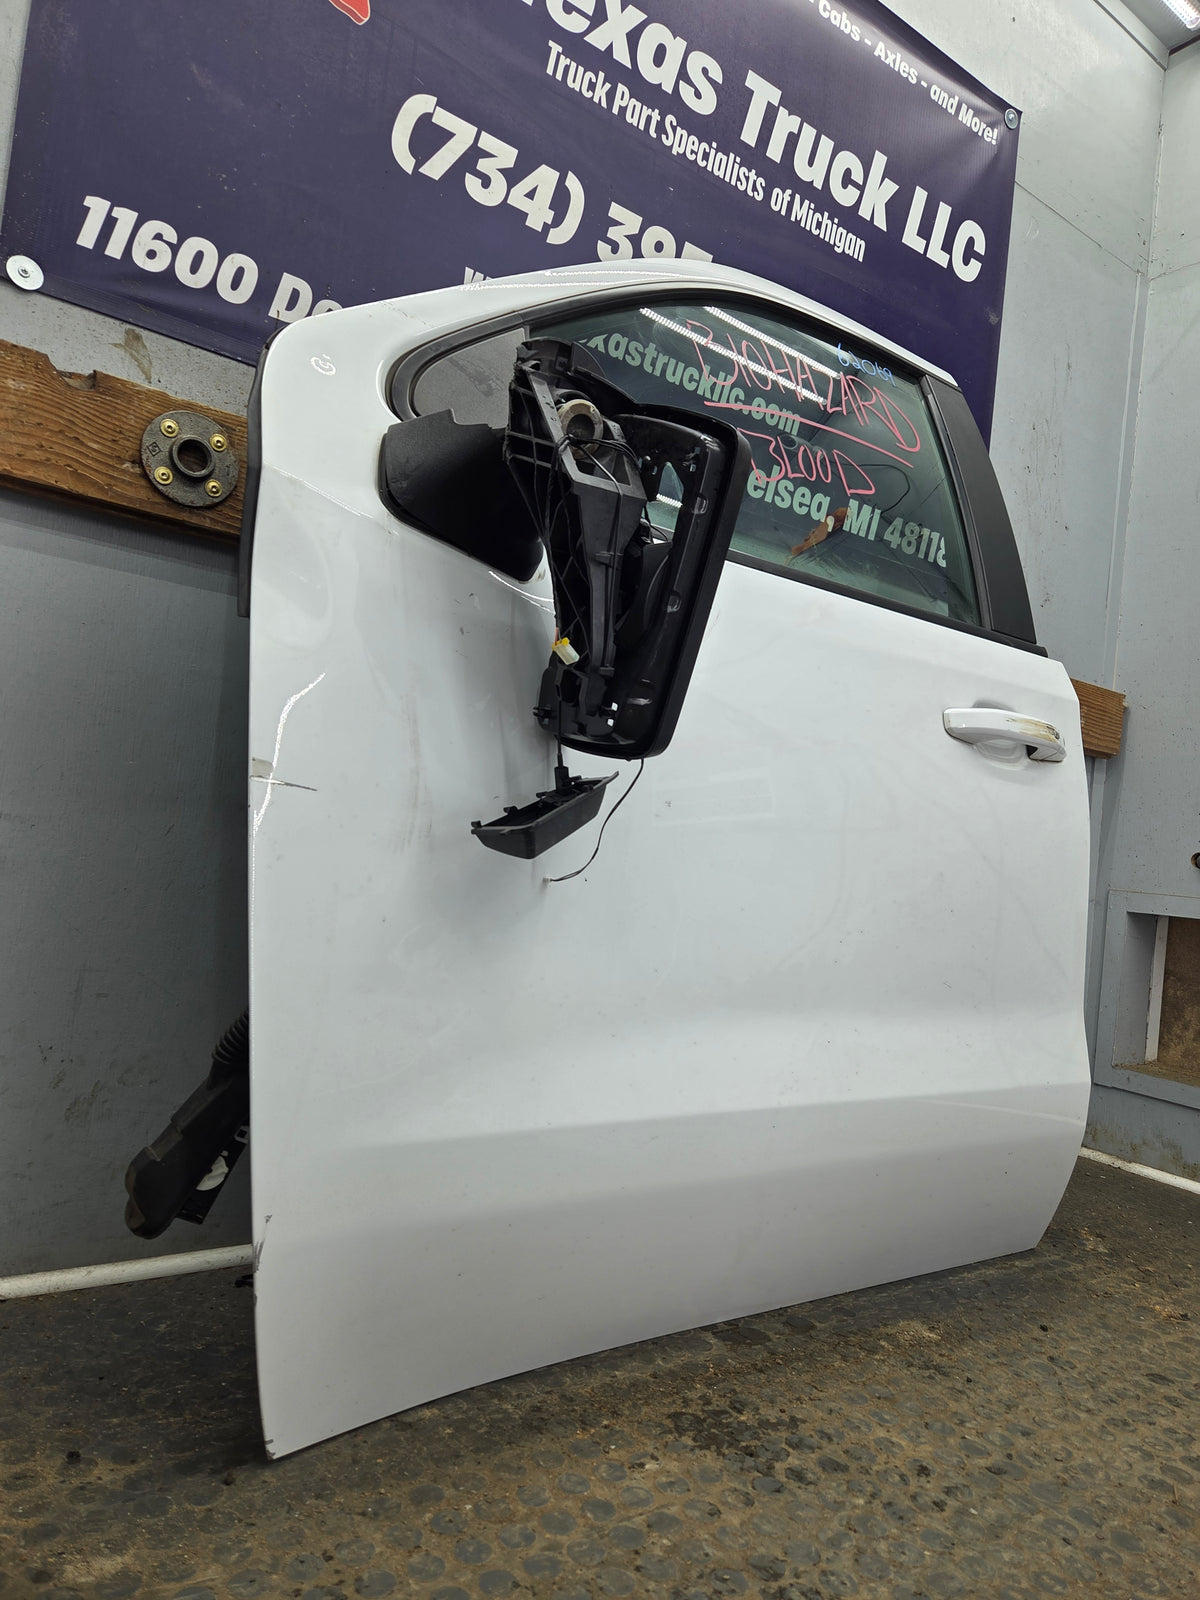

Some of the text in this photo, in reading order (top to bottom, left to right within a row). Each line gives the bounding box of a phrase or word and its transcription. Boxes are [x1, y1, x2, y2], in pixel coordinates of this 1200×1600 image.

[522, 0, 986, 283] exas Truck LLC
[818, 0, 861, 42] Cabs
[874, 41, 918, 84] Axles
[930, 84, 959, 115] and
[958, 103, 998, 145] More!
[391, 94, 713, 262] (734) 39
[546, 40, 866, 262] Truck Part Specialists of Michigan
[76, 195, 258, 304] 11600
[578, 333, 800, 435] xastruckllc.com
[686, 319, 921, 452] BIOHAZARD
[842, 498, 881, 541] MI
